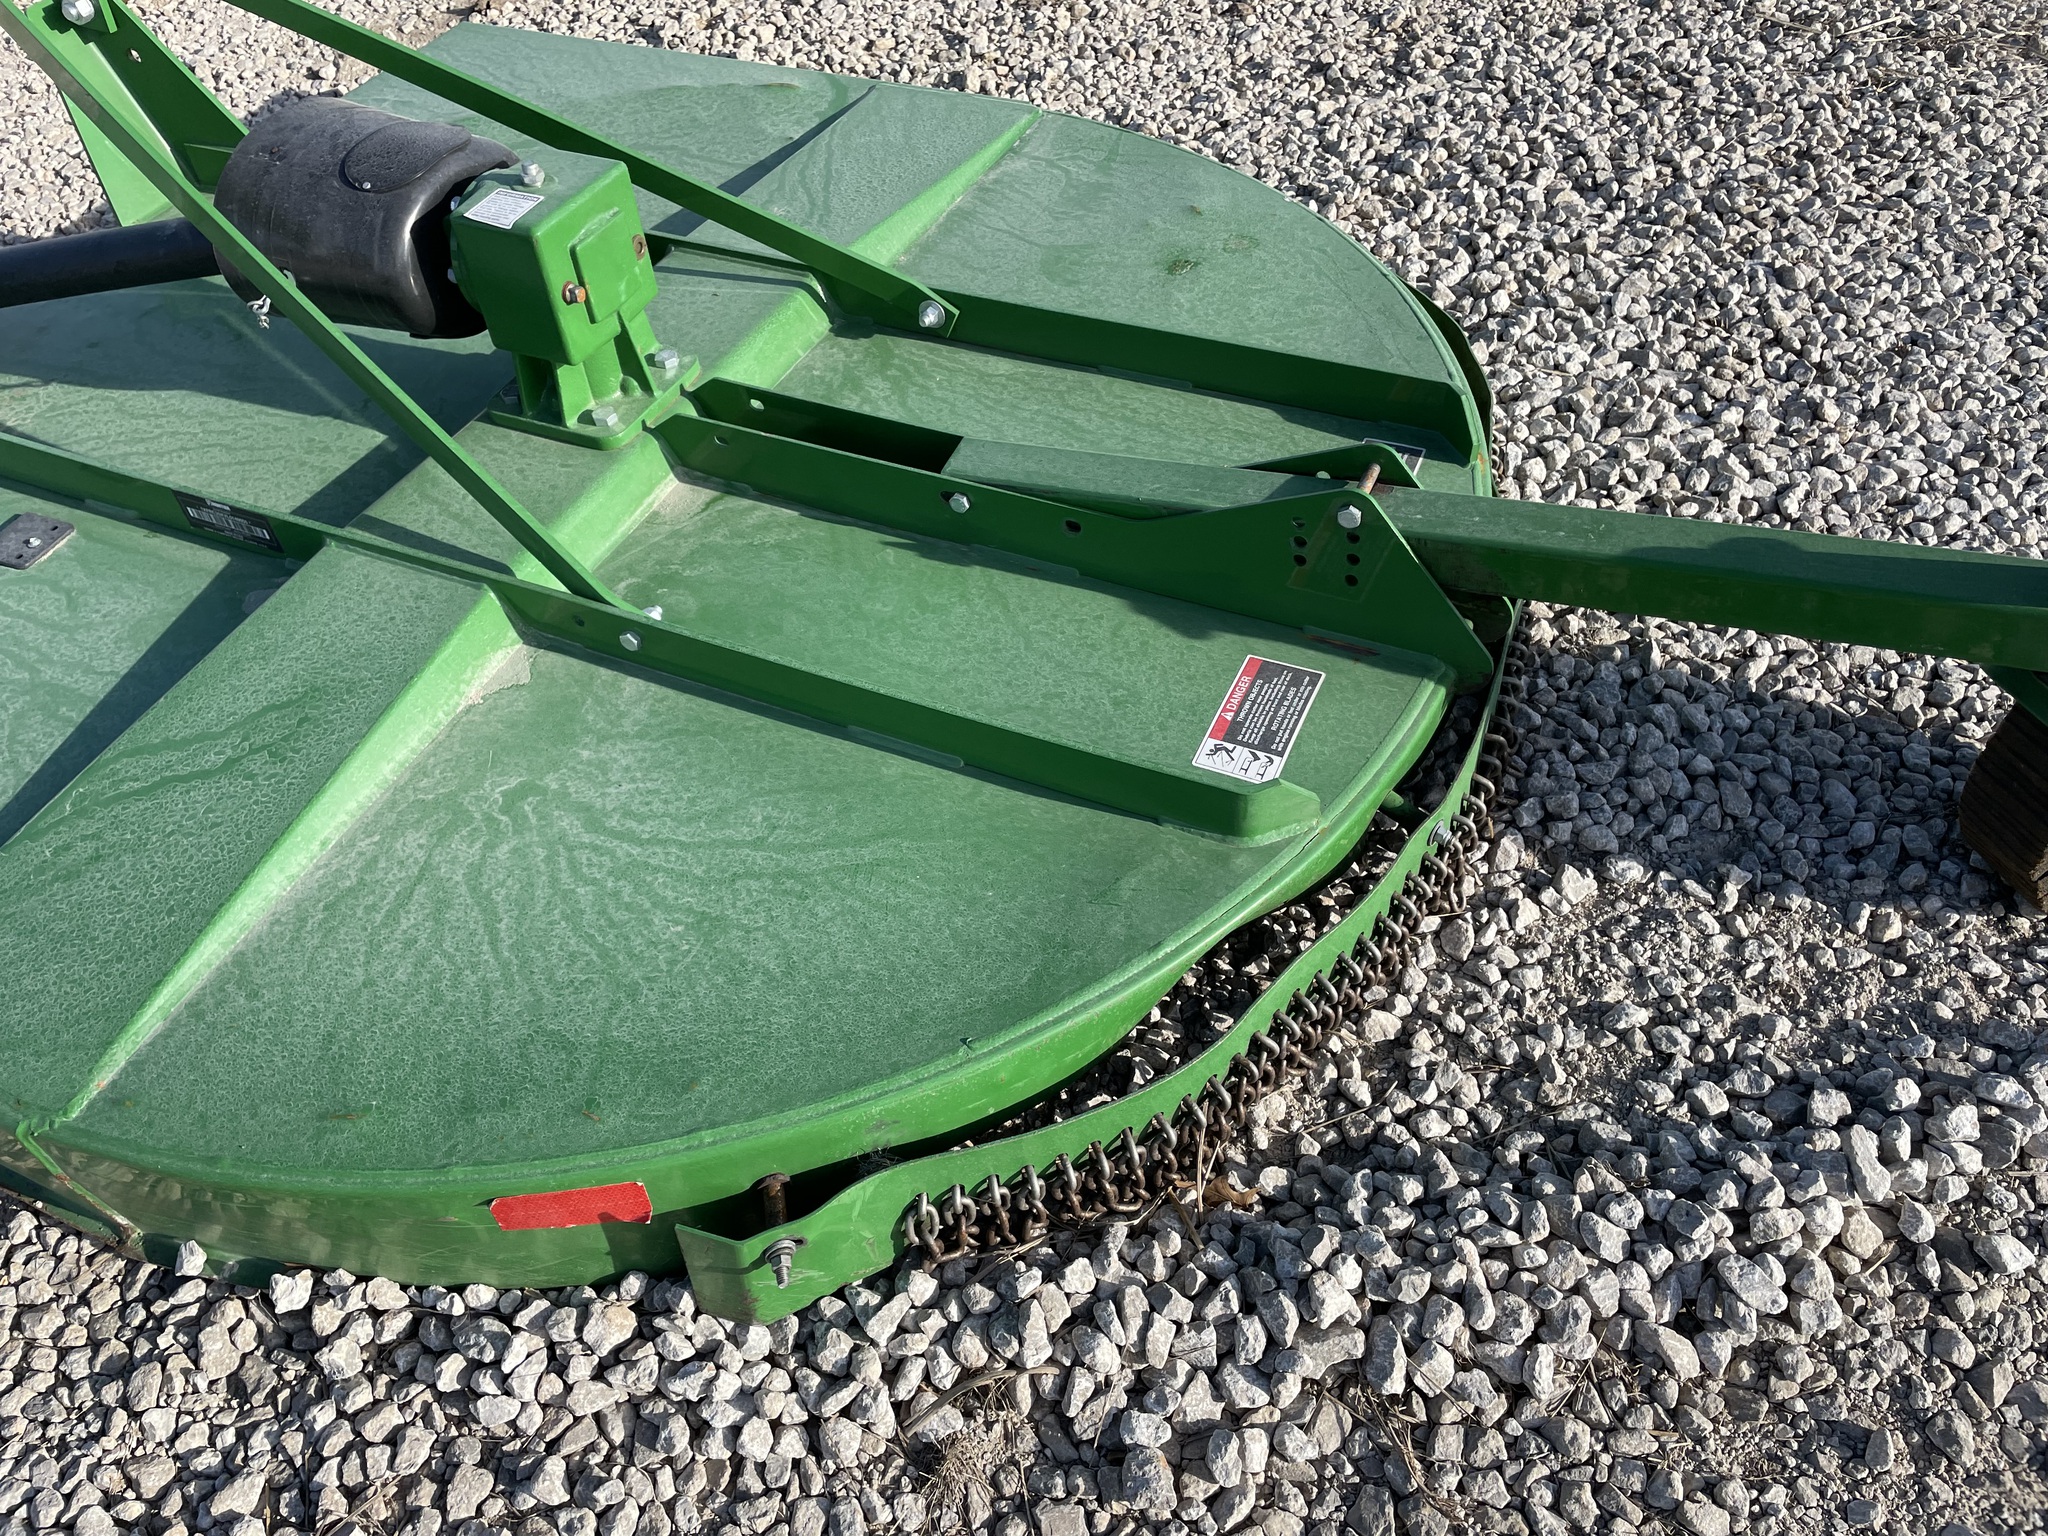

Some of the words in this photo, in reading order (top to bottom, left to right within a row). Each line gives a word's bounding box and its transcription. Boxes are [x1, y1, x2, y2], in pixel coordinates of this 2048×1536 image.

[1226, 676, 1252, 710] DANGER
[1236, 700, 1252, 722] THROWN
[1247, 679, 1263, 701] OBJECTS
[1270, 706, 1288, 731] ROTATING
[1283, 687, 1297, 706] BLADES
